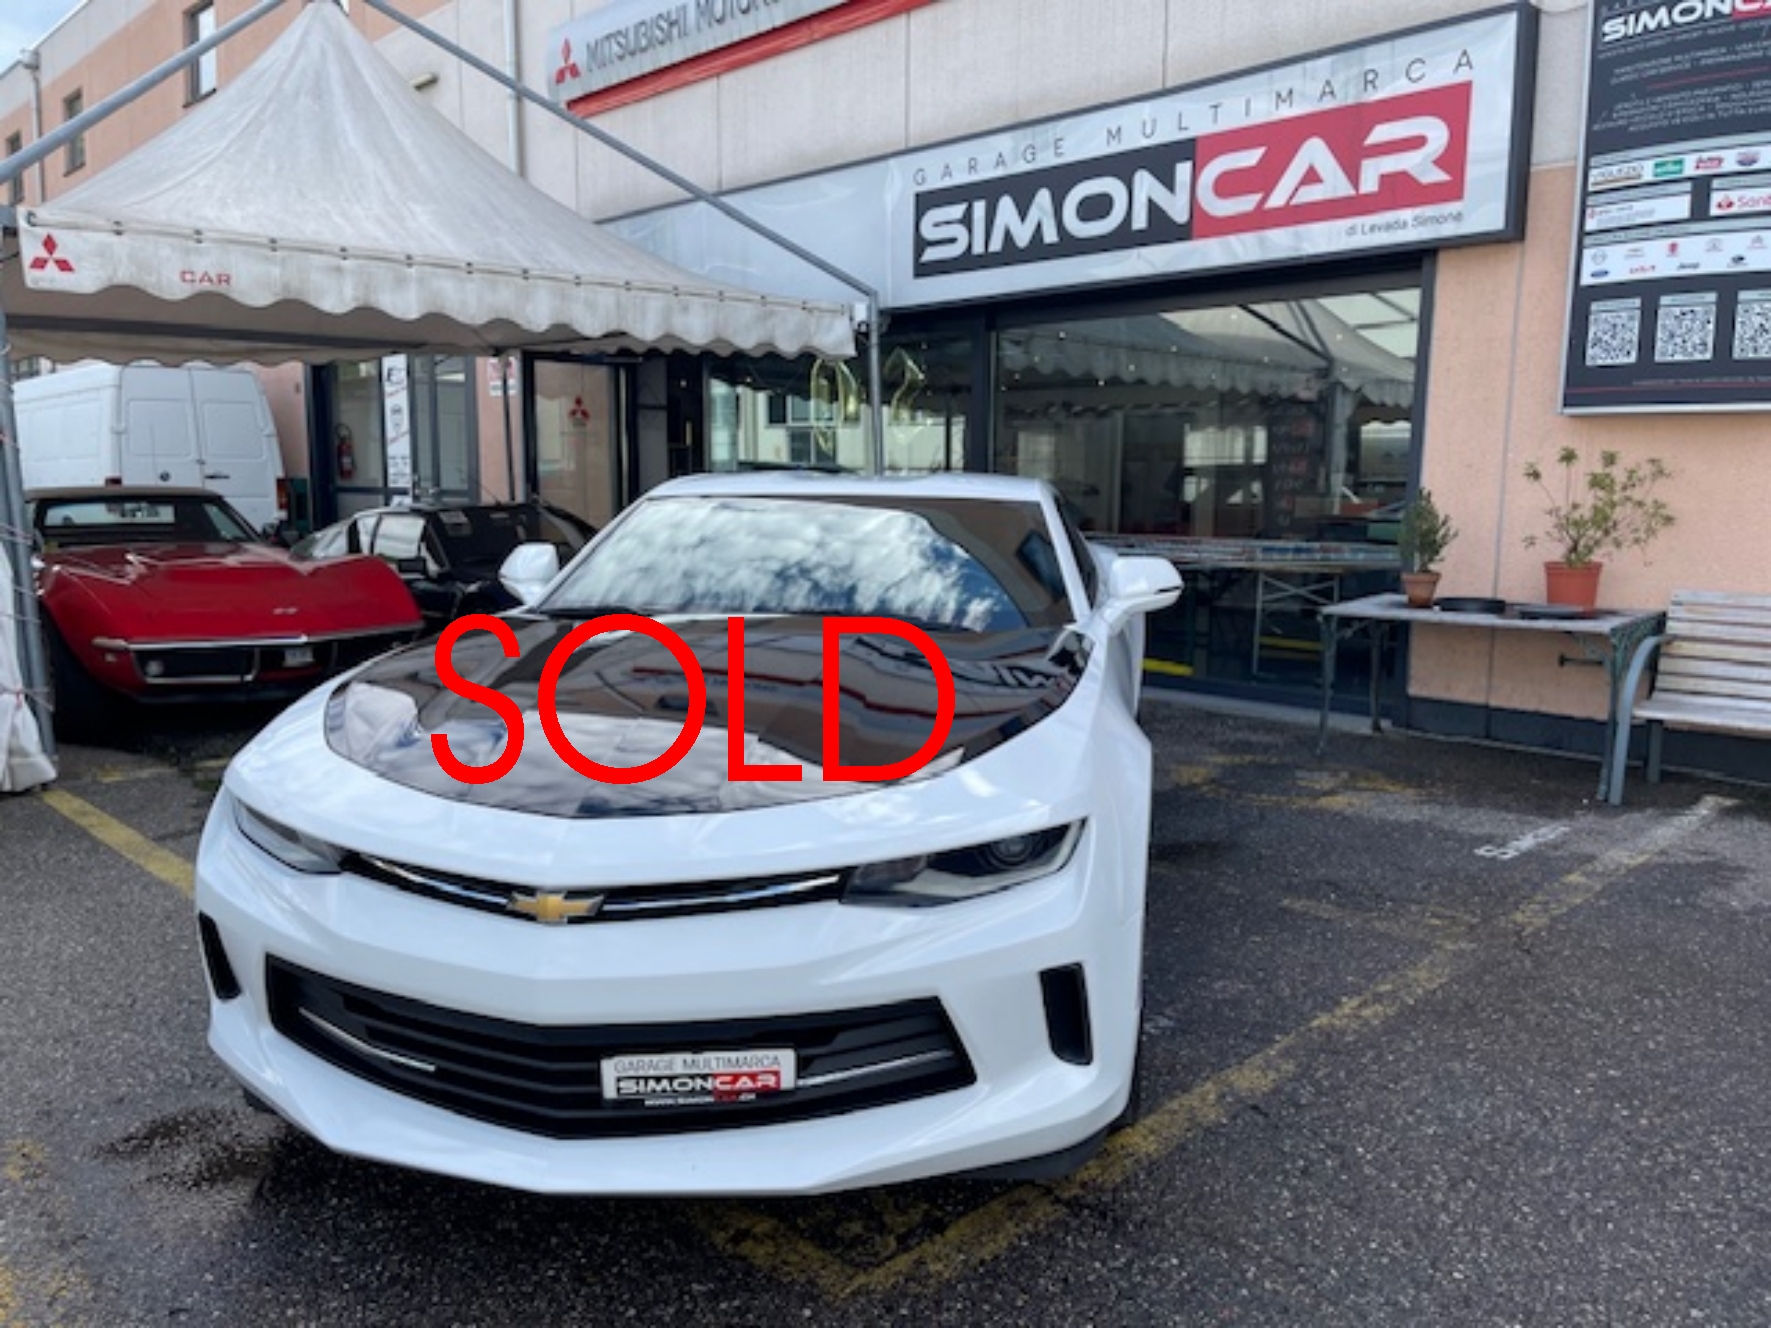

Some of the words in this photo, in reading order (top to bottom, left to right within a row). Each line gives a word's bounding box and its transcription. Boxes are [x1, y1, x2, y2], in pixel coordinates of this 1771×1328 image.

[585, 3, 688, 72] MITSUBISHI
[697, 0, 779, 34] MOT
[913, 137, 1065, 187] GARAGE
[1106, 48, 1475, 147] MULTIMARCA
[918, 115, 1454, 263] SIMONCAR
[1345, 223, 1358, 236] di
[1361, 215, 1409, 236] Levada
[1411, 209, 1464, 230] Simone
[179, 269, 232, 287] CAR
[614, 1057, 674, 1074] GARAGE
[682, 1054, 781, 1072] MULTIMARCA
[617, 1073, 778, 1094] SIMONCAR
